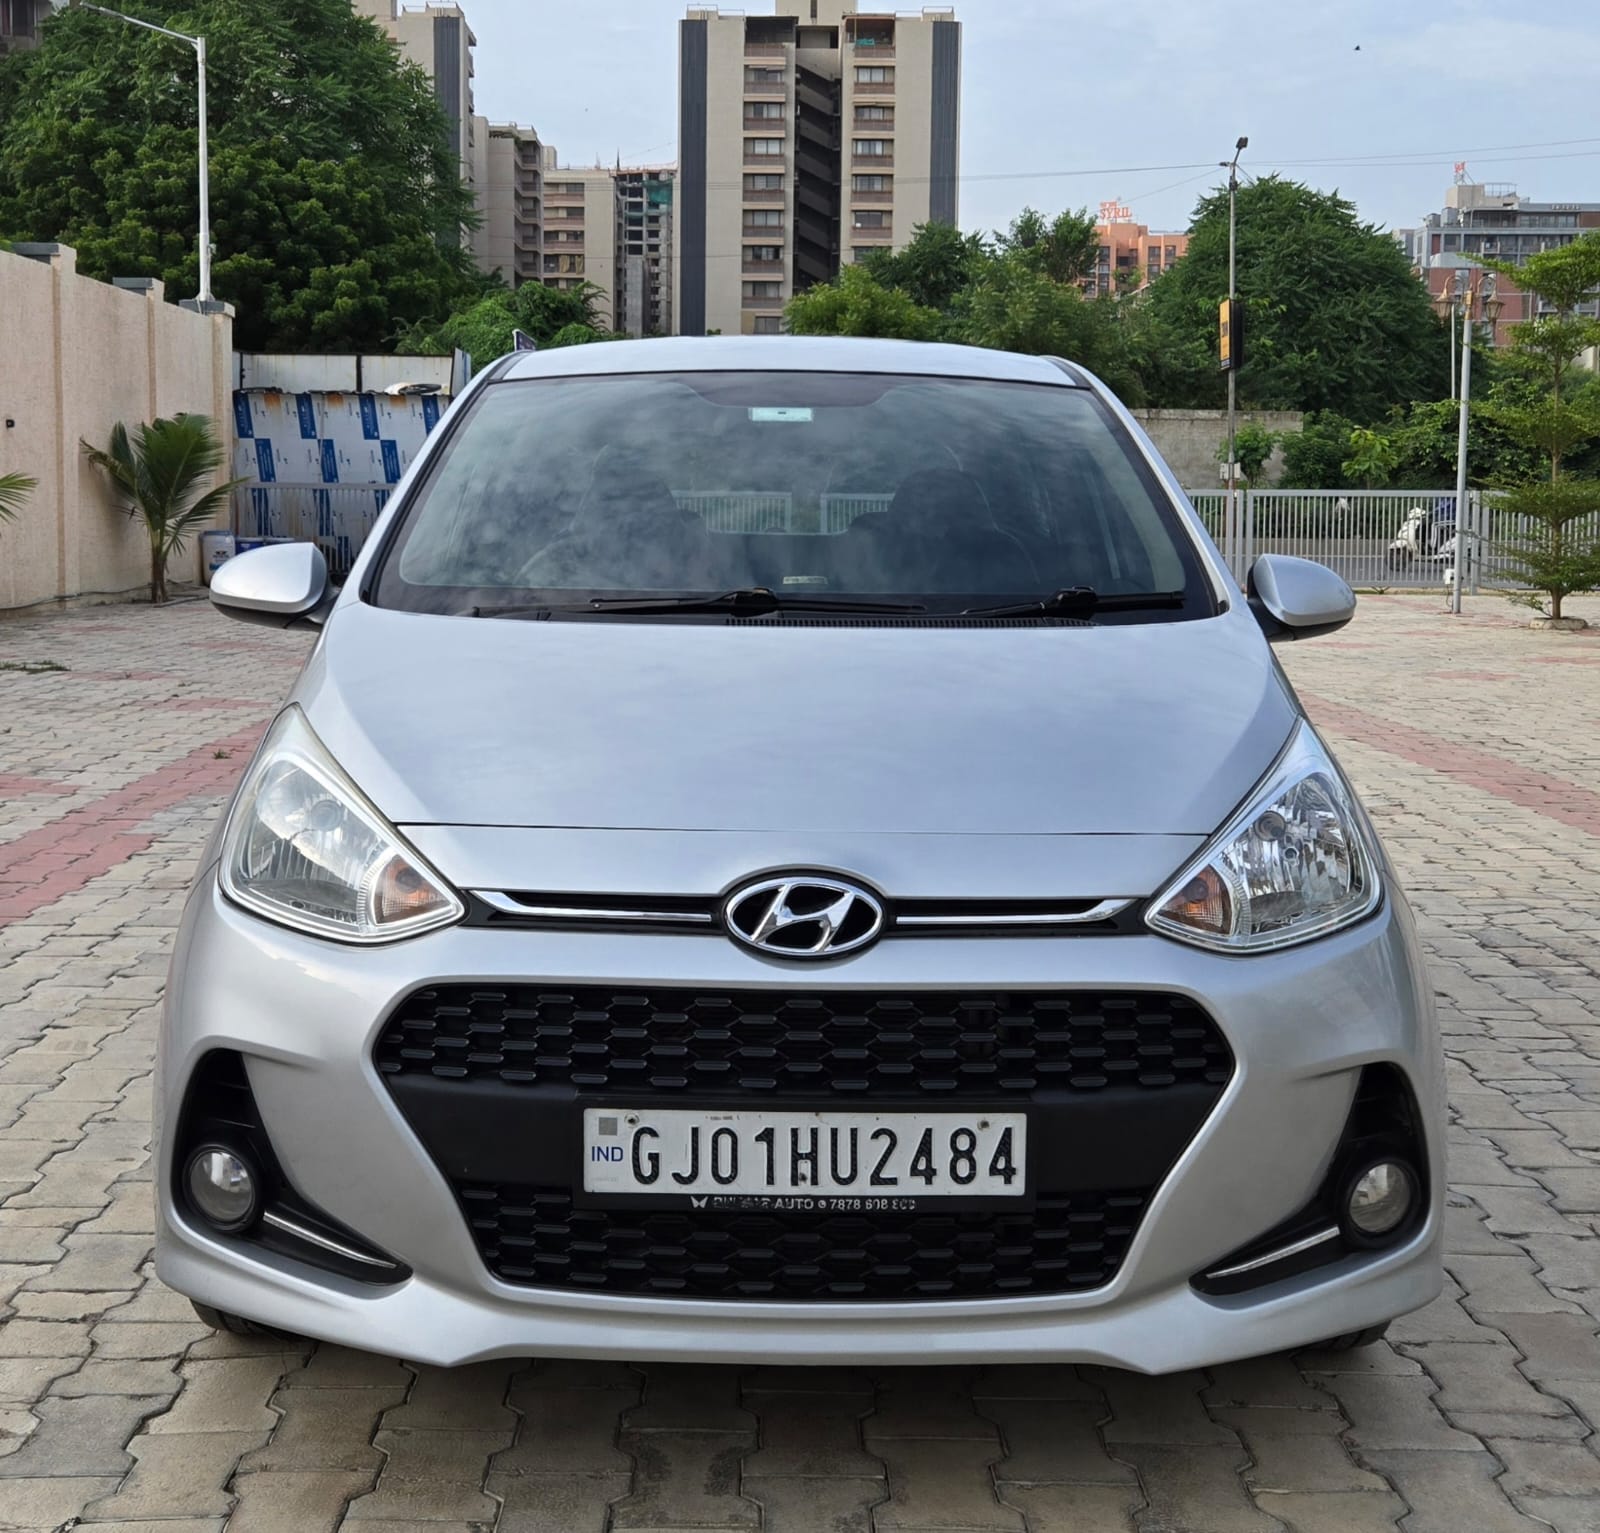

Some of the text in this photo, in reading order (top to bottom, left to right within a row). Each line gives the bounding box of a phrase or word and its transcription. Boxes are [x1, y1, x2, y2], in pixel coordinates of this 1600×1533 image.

[591, 1145, 624, 1162] IND
[631, 1126, 1017, 1187] GJ01HU2484
[774, 1198, 815, 1210] AUTO
[829, 1198, 861, 1211] 7878
